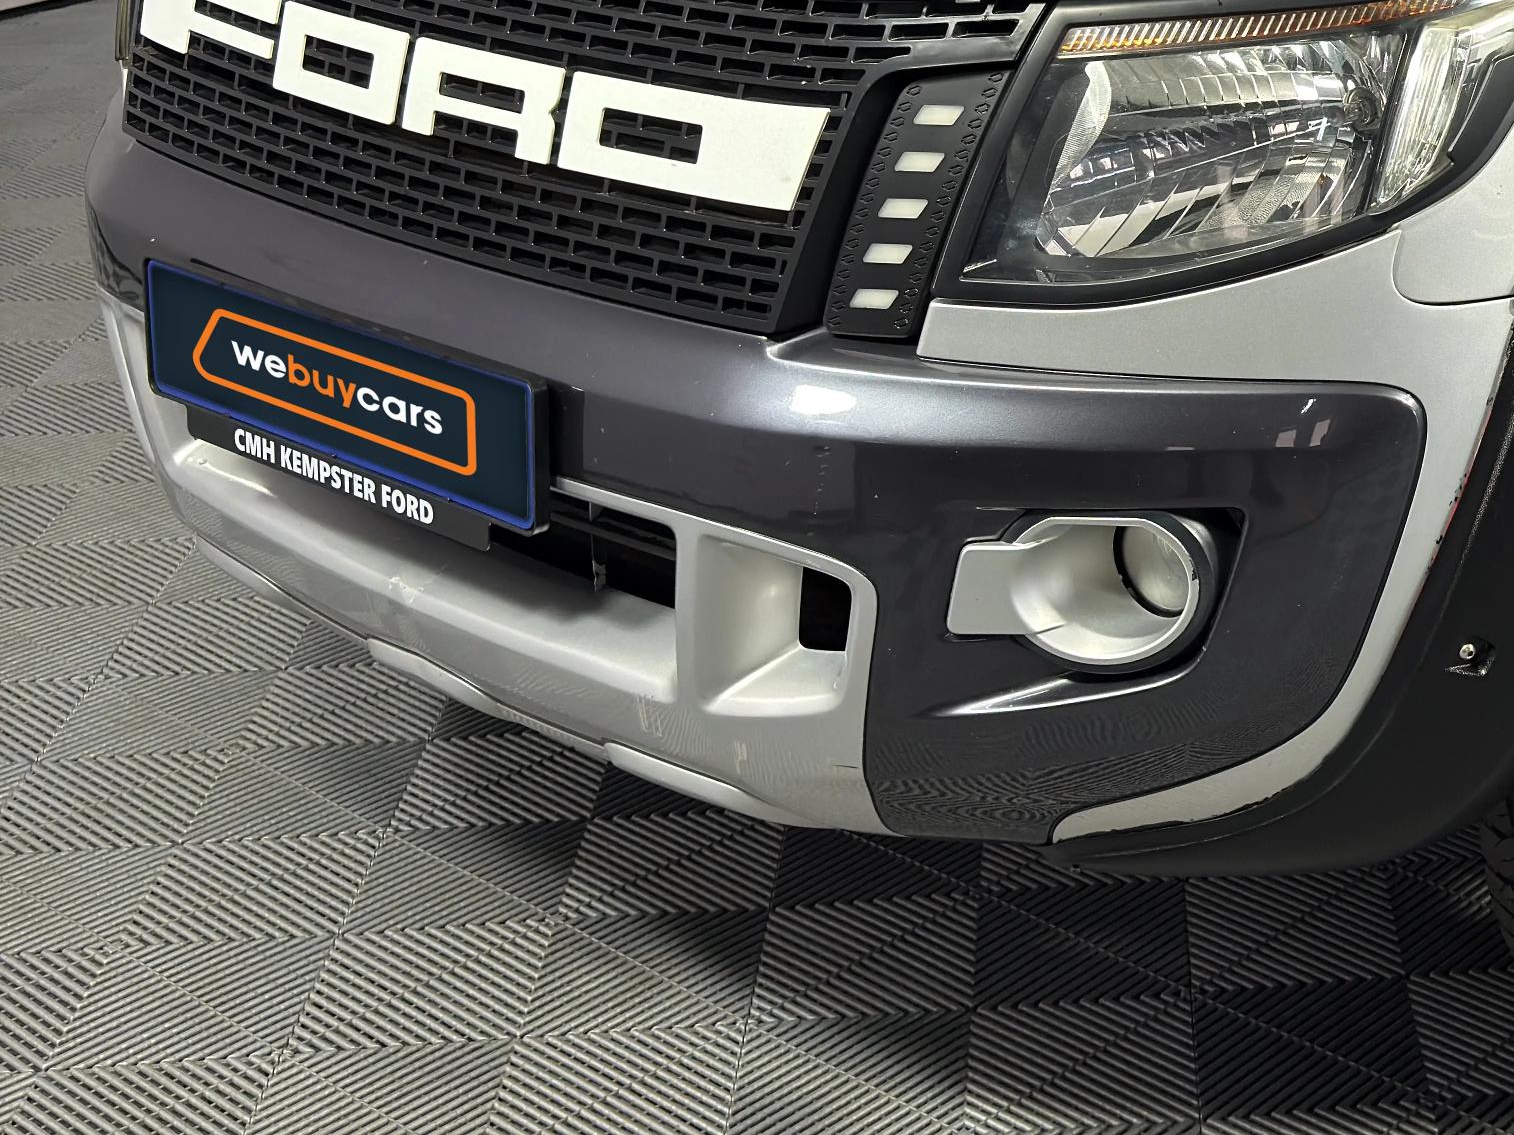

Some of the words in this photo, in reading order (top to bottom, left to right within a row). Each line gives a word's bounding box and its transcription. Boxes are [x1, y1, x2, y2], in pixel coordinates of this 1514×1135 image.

[231, 340, 443, 435] webuycars
[234, 428, 276, 464] CMH
[280, 444, 377, 504] KEMPSTER
[381, 483, 434, 525] FORD
